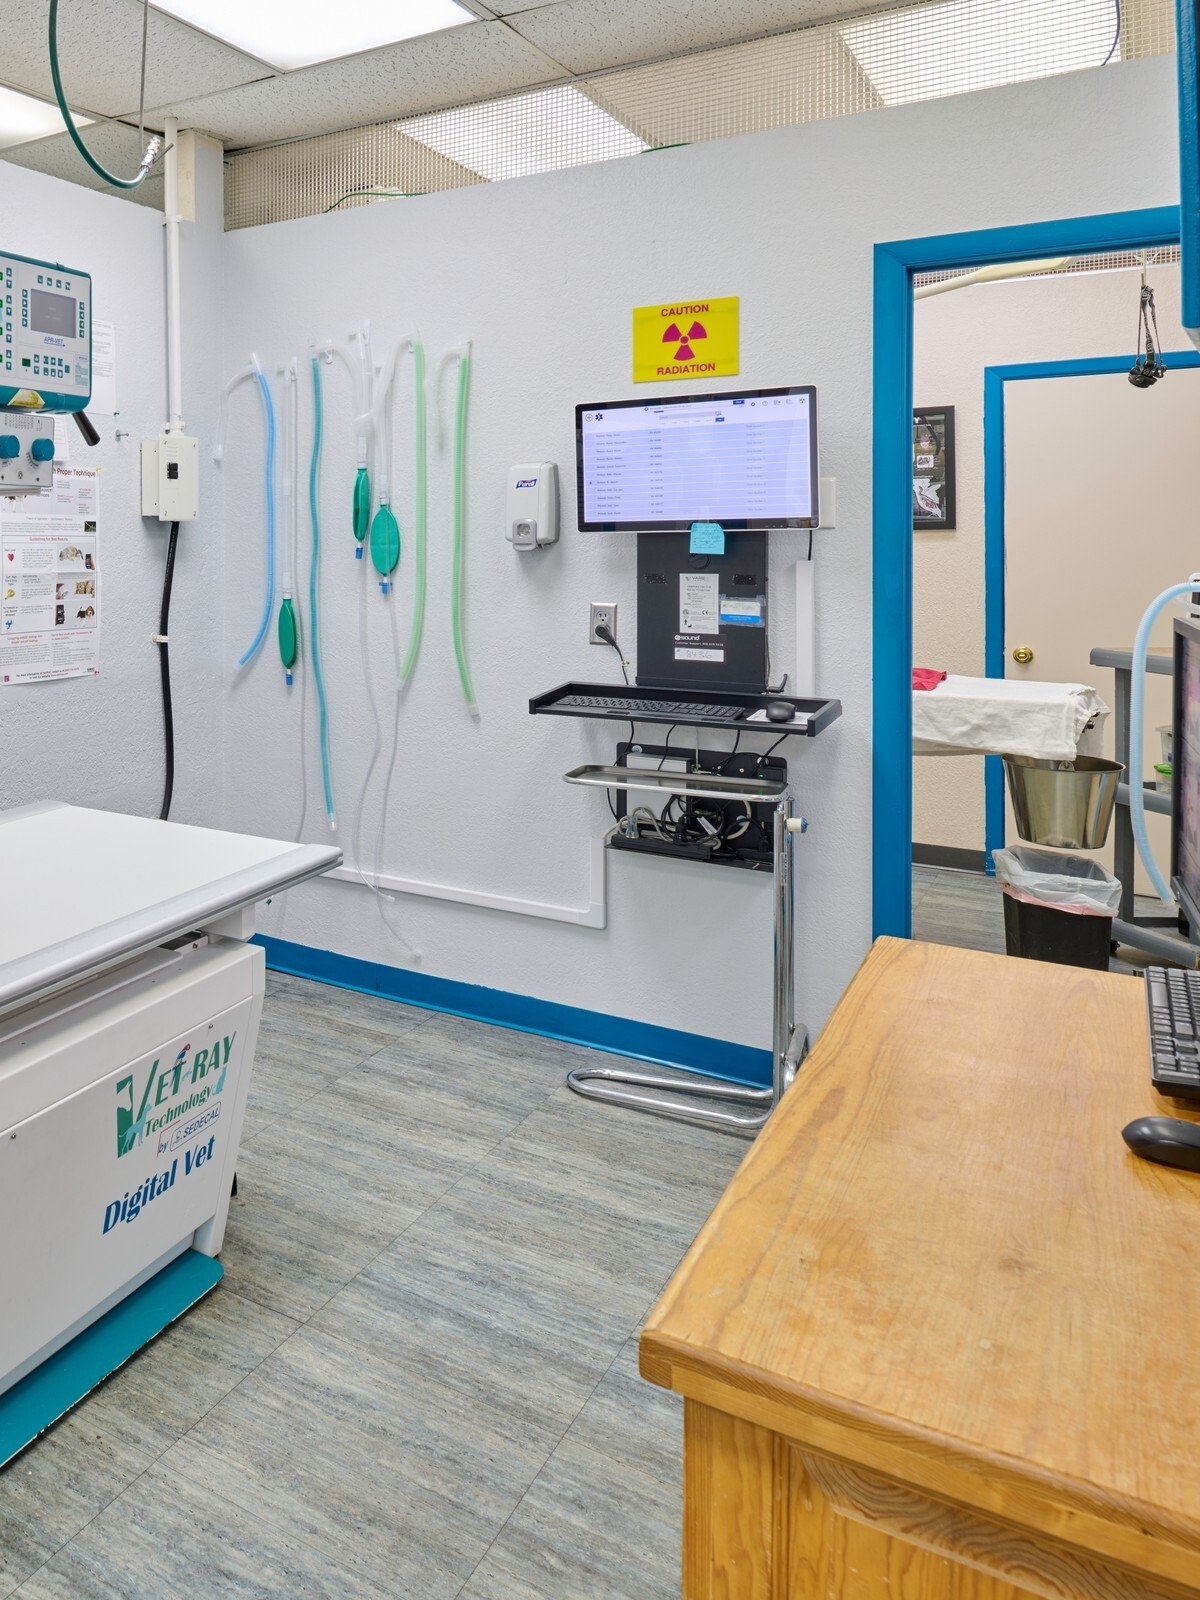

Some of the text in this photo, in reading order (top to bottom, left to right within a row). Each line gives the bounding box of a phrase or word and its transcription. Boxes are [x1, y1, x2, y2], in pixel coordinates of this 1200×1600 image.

[660, 304, 709, 317] CAUTION
[657, 362, 716, 376] RADIATION
[57, 468, 72, 476] Proper
[73, 469, 96, 478] Technique
[145, 1084, 213, 1137] Technology
[158, 1108, 220, 1153] by SEDECAL
[102, 1135, 216, 1235] Digital Vet
